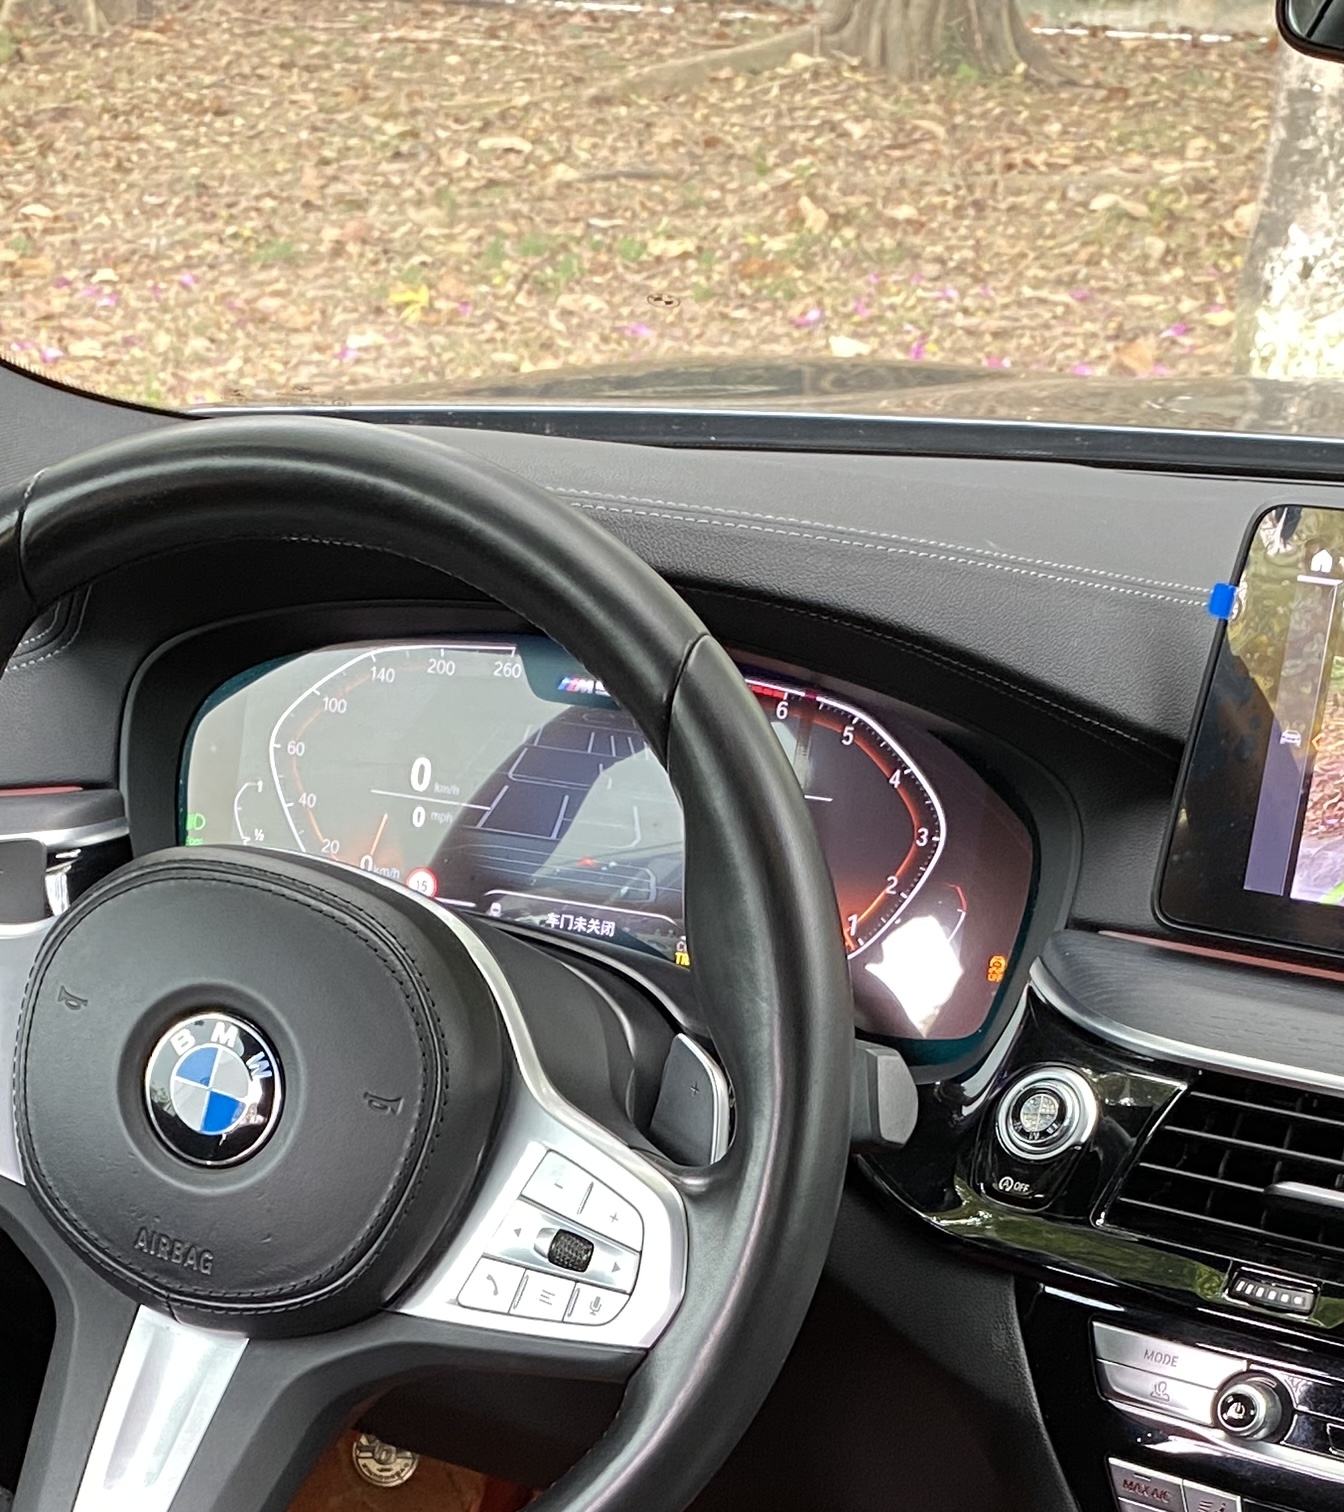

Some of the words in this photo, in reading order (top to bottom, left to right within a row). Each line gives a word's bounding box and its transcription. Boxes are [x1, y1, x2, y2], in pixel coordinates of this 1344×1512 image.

[370, 665, 396, 684] 140
[427, 658, 456, 676] 200
[493, 662, 522, 679] 260
[322, 697, 347, 714] 100
[776, 701, 788, 720] 6
[841, 726, 854, 746] 5
[287, 740, 305, 757] 60
[410, 756, 432, 793] 0
[434, 782, 460, 796] km/h
[888, 769, 901, 789] 4
[298, 792, 316, 808] 40
[412, 806, 426, 828] 0
[430, 811, 453, 824] mph
[321, 839, 340, 854] 20
[915, 827, 929, 847] 3
[416, 879, 428, 893] 15
[885, 875, 898, 894] 2
[545, 912, 616, 937] 车门未关闭
[847, 914, 858, 936] 1
[170, 1021, 273, 1080] BMW
[1013, 1181, 1030, 1193] OFF
[135, 1227, 214, 1275] AIRBAG
[1143, 1349, 1179, 1369] MODE
[1123, 1479, 1149, 1496] MAX
[1149, 1487, 1171, 1504] A/C
